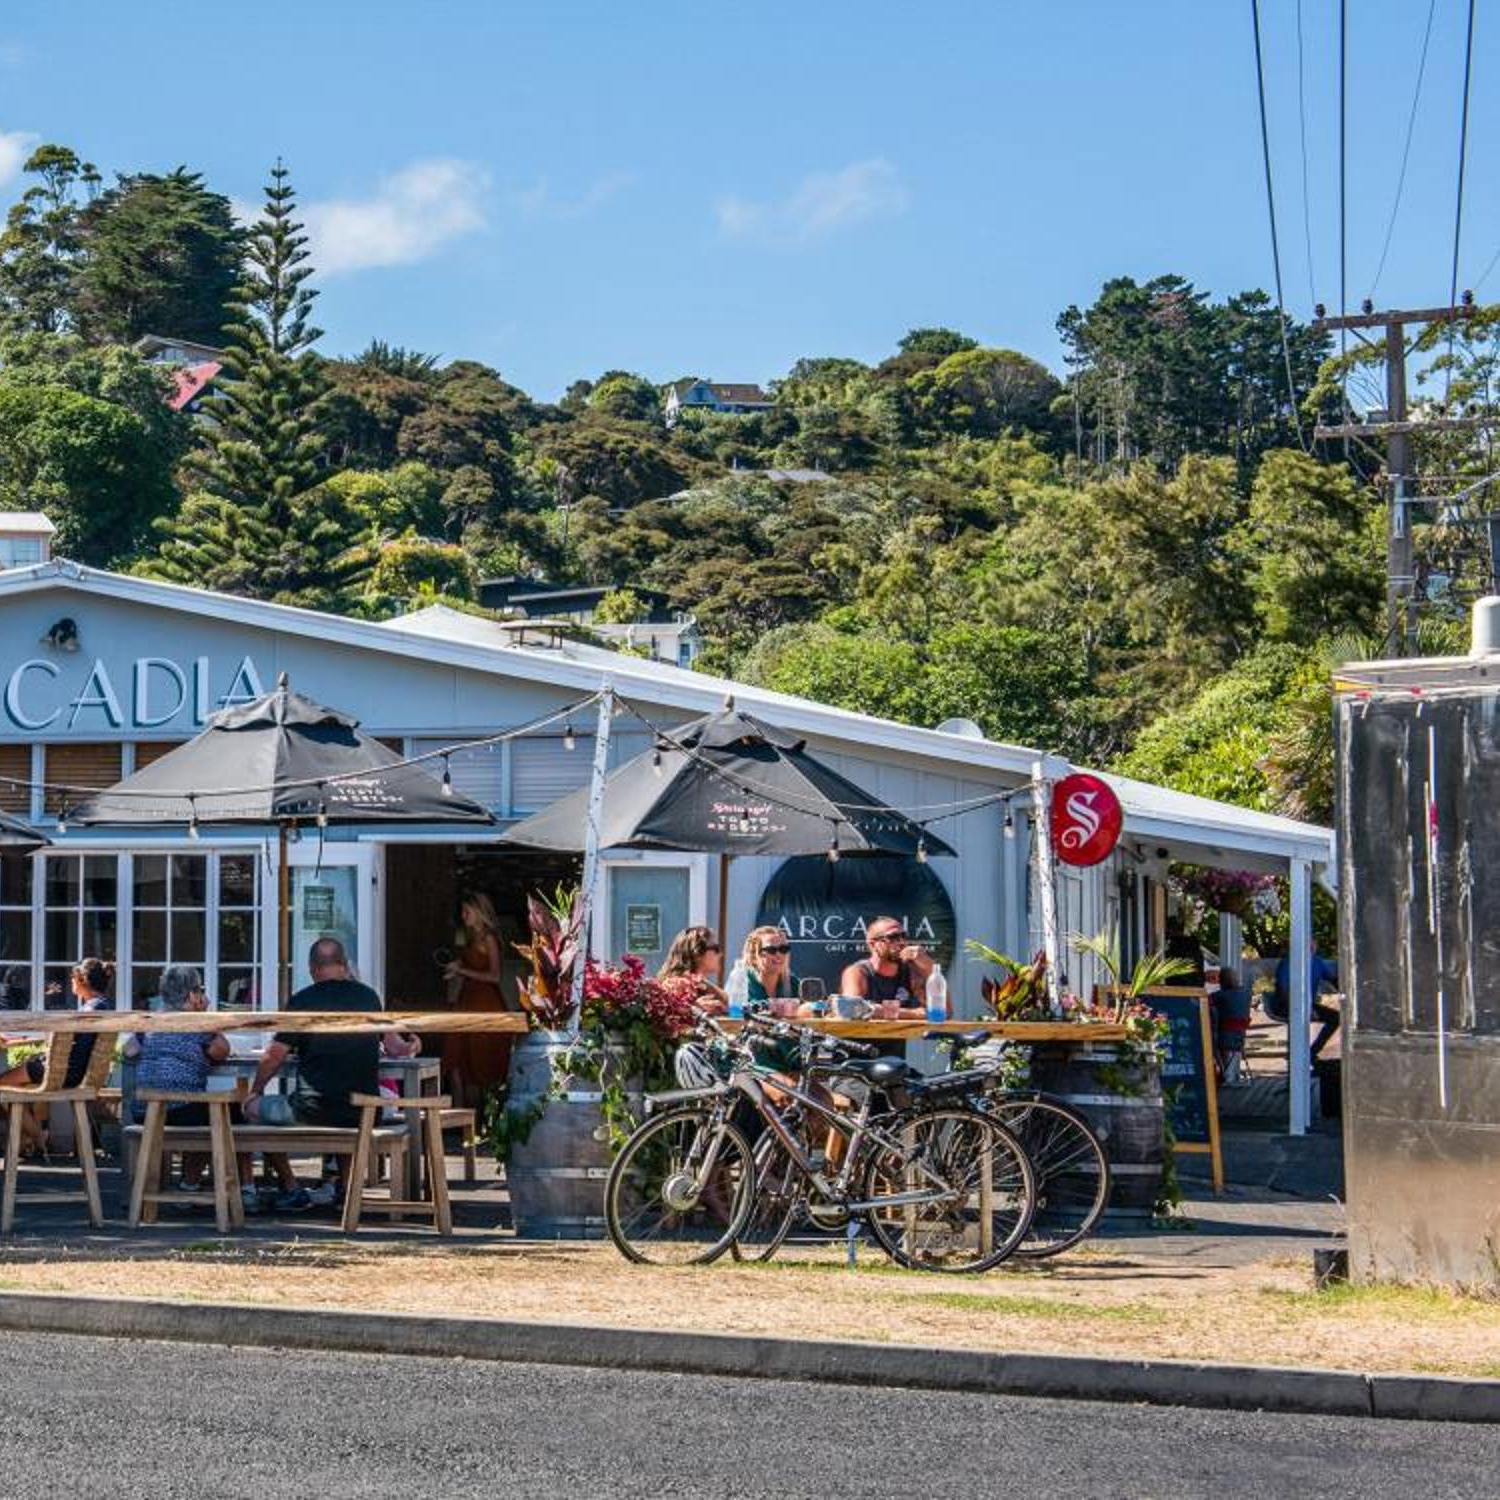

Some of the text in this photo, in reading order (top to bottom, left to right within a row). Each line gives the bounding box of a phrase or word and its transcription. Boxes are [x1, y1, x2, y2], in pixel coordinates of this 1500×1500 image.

[719, 815, 770, 824] TOYO
[729, 823, 759, 833] DY
[776, 914, 936, 939] ARCAIA
